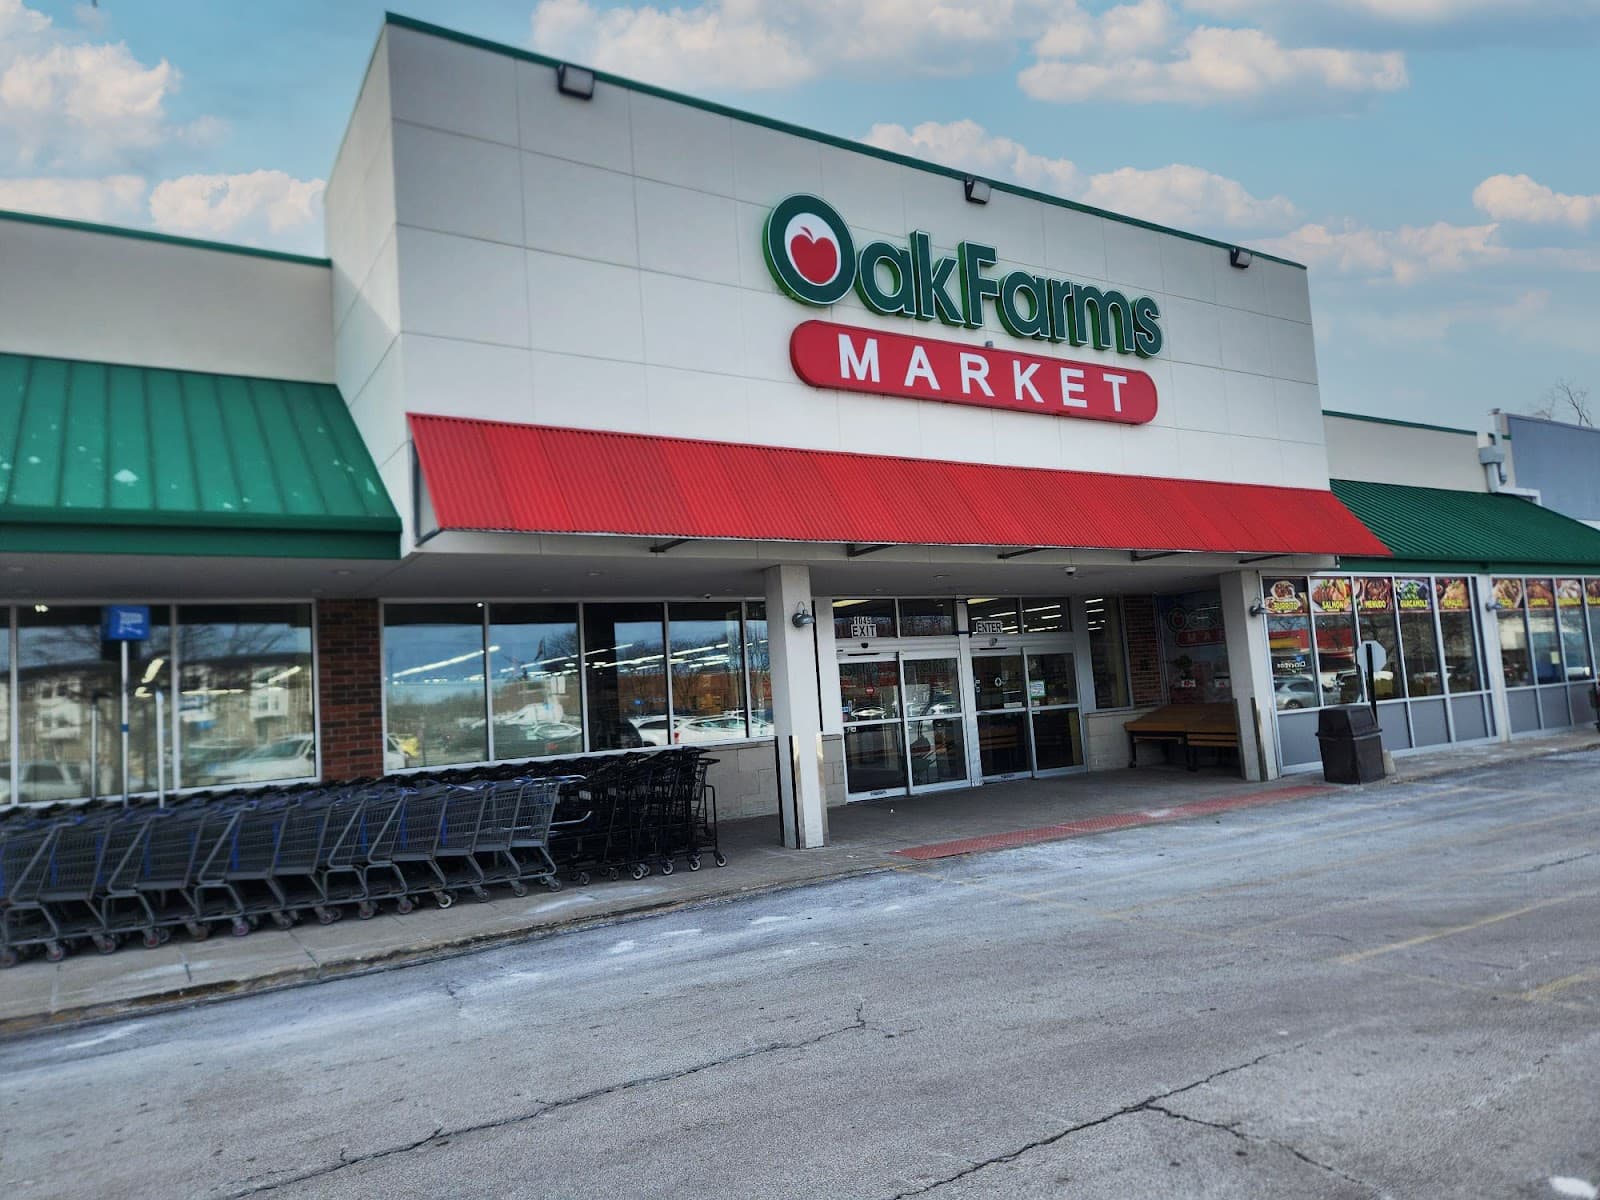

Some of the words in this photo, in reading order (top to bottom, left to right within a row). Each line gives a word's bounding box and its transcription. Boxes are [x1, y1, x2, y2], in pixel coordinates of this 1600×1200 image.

[838, 333, 1128, 412] MARKET
[1273, 601, 1299, 611] BURRITO
[1322, 600, 1344, 609] SALMON
[852, 625, 876, 637] EXIT
[977, 622, 1002, 633] ENTER
